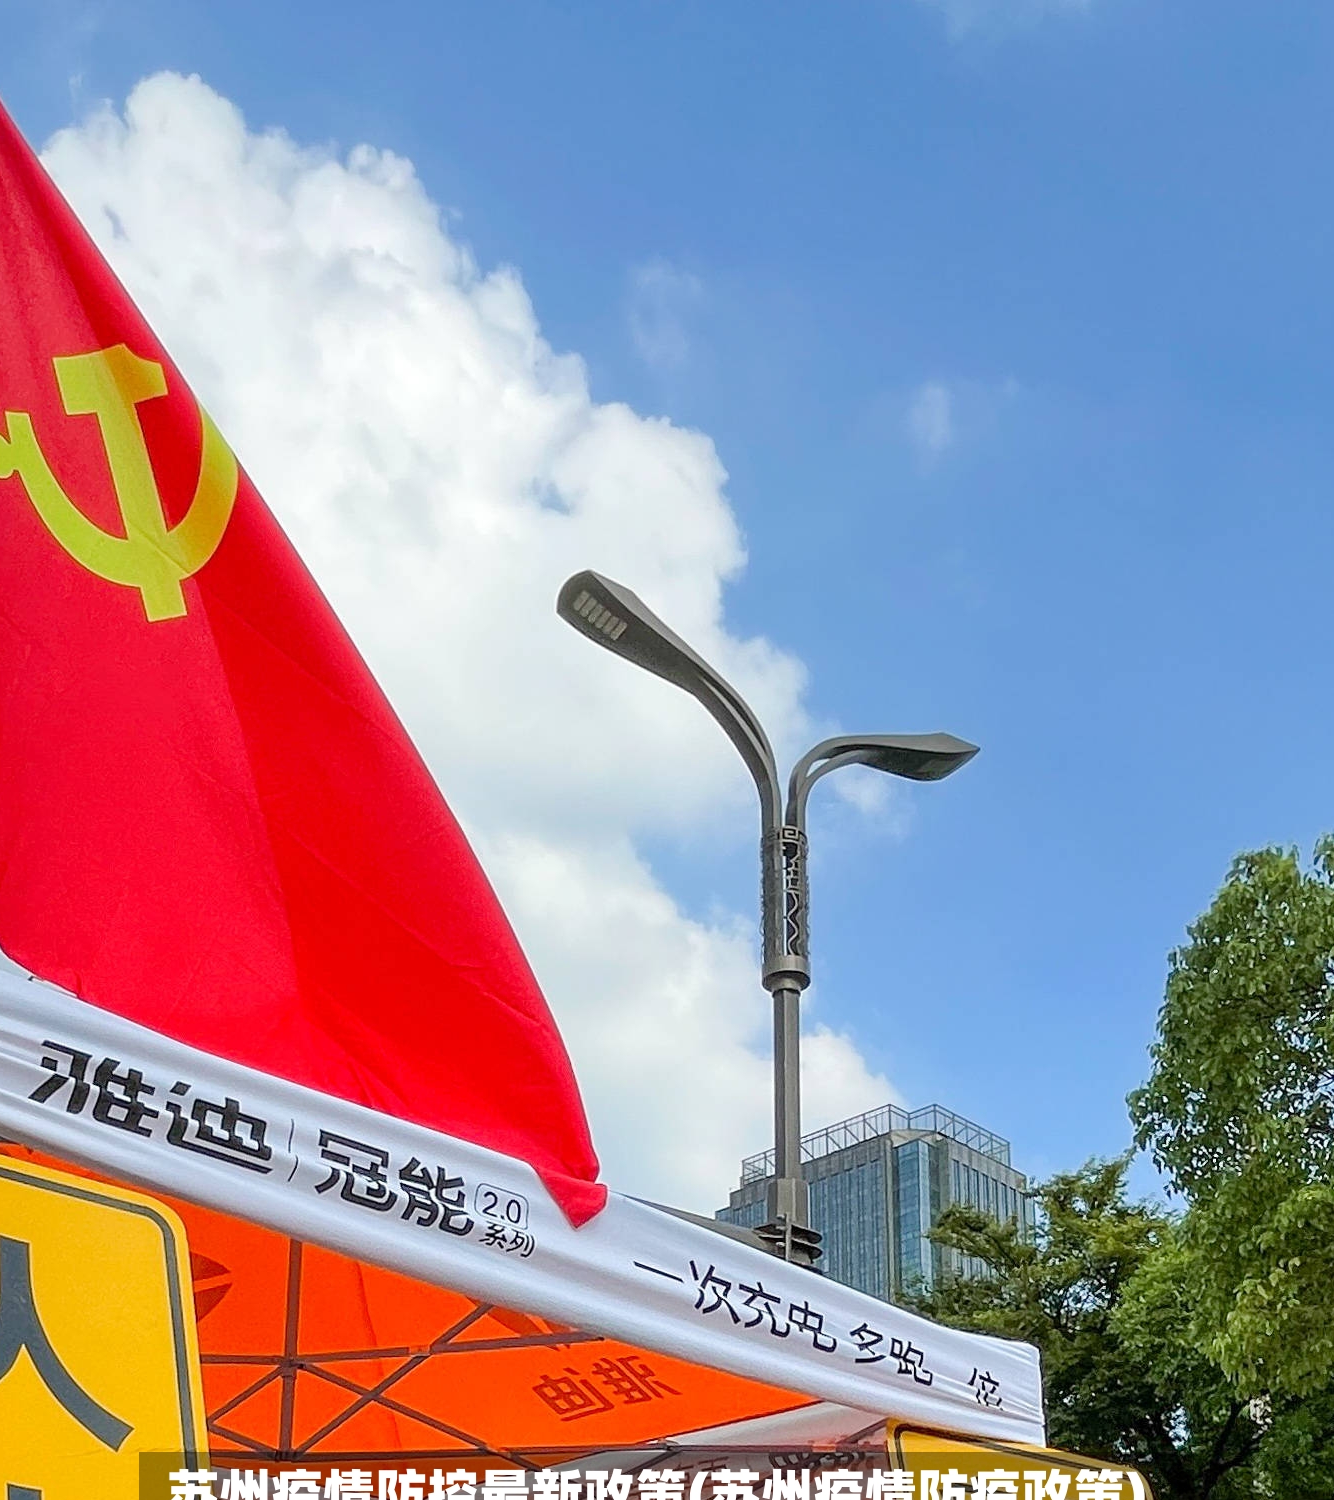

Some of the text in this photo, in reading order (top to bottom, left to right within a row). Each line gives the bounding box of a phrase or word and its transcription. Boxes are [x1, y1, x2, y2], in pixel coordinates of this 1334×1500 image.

[28, 1040, 474, 1237] 雅迪 冠能
[479, 1222, 536, 1258] 系列
[482, 1191, 521, 1225] 2.0
[634, 1260, 837, 1353] 一次充电
